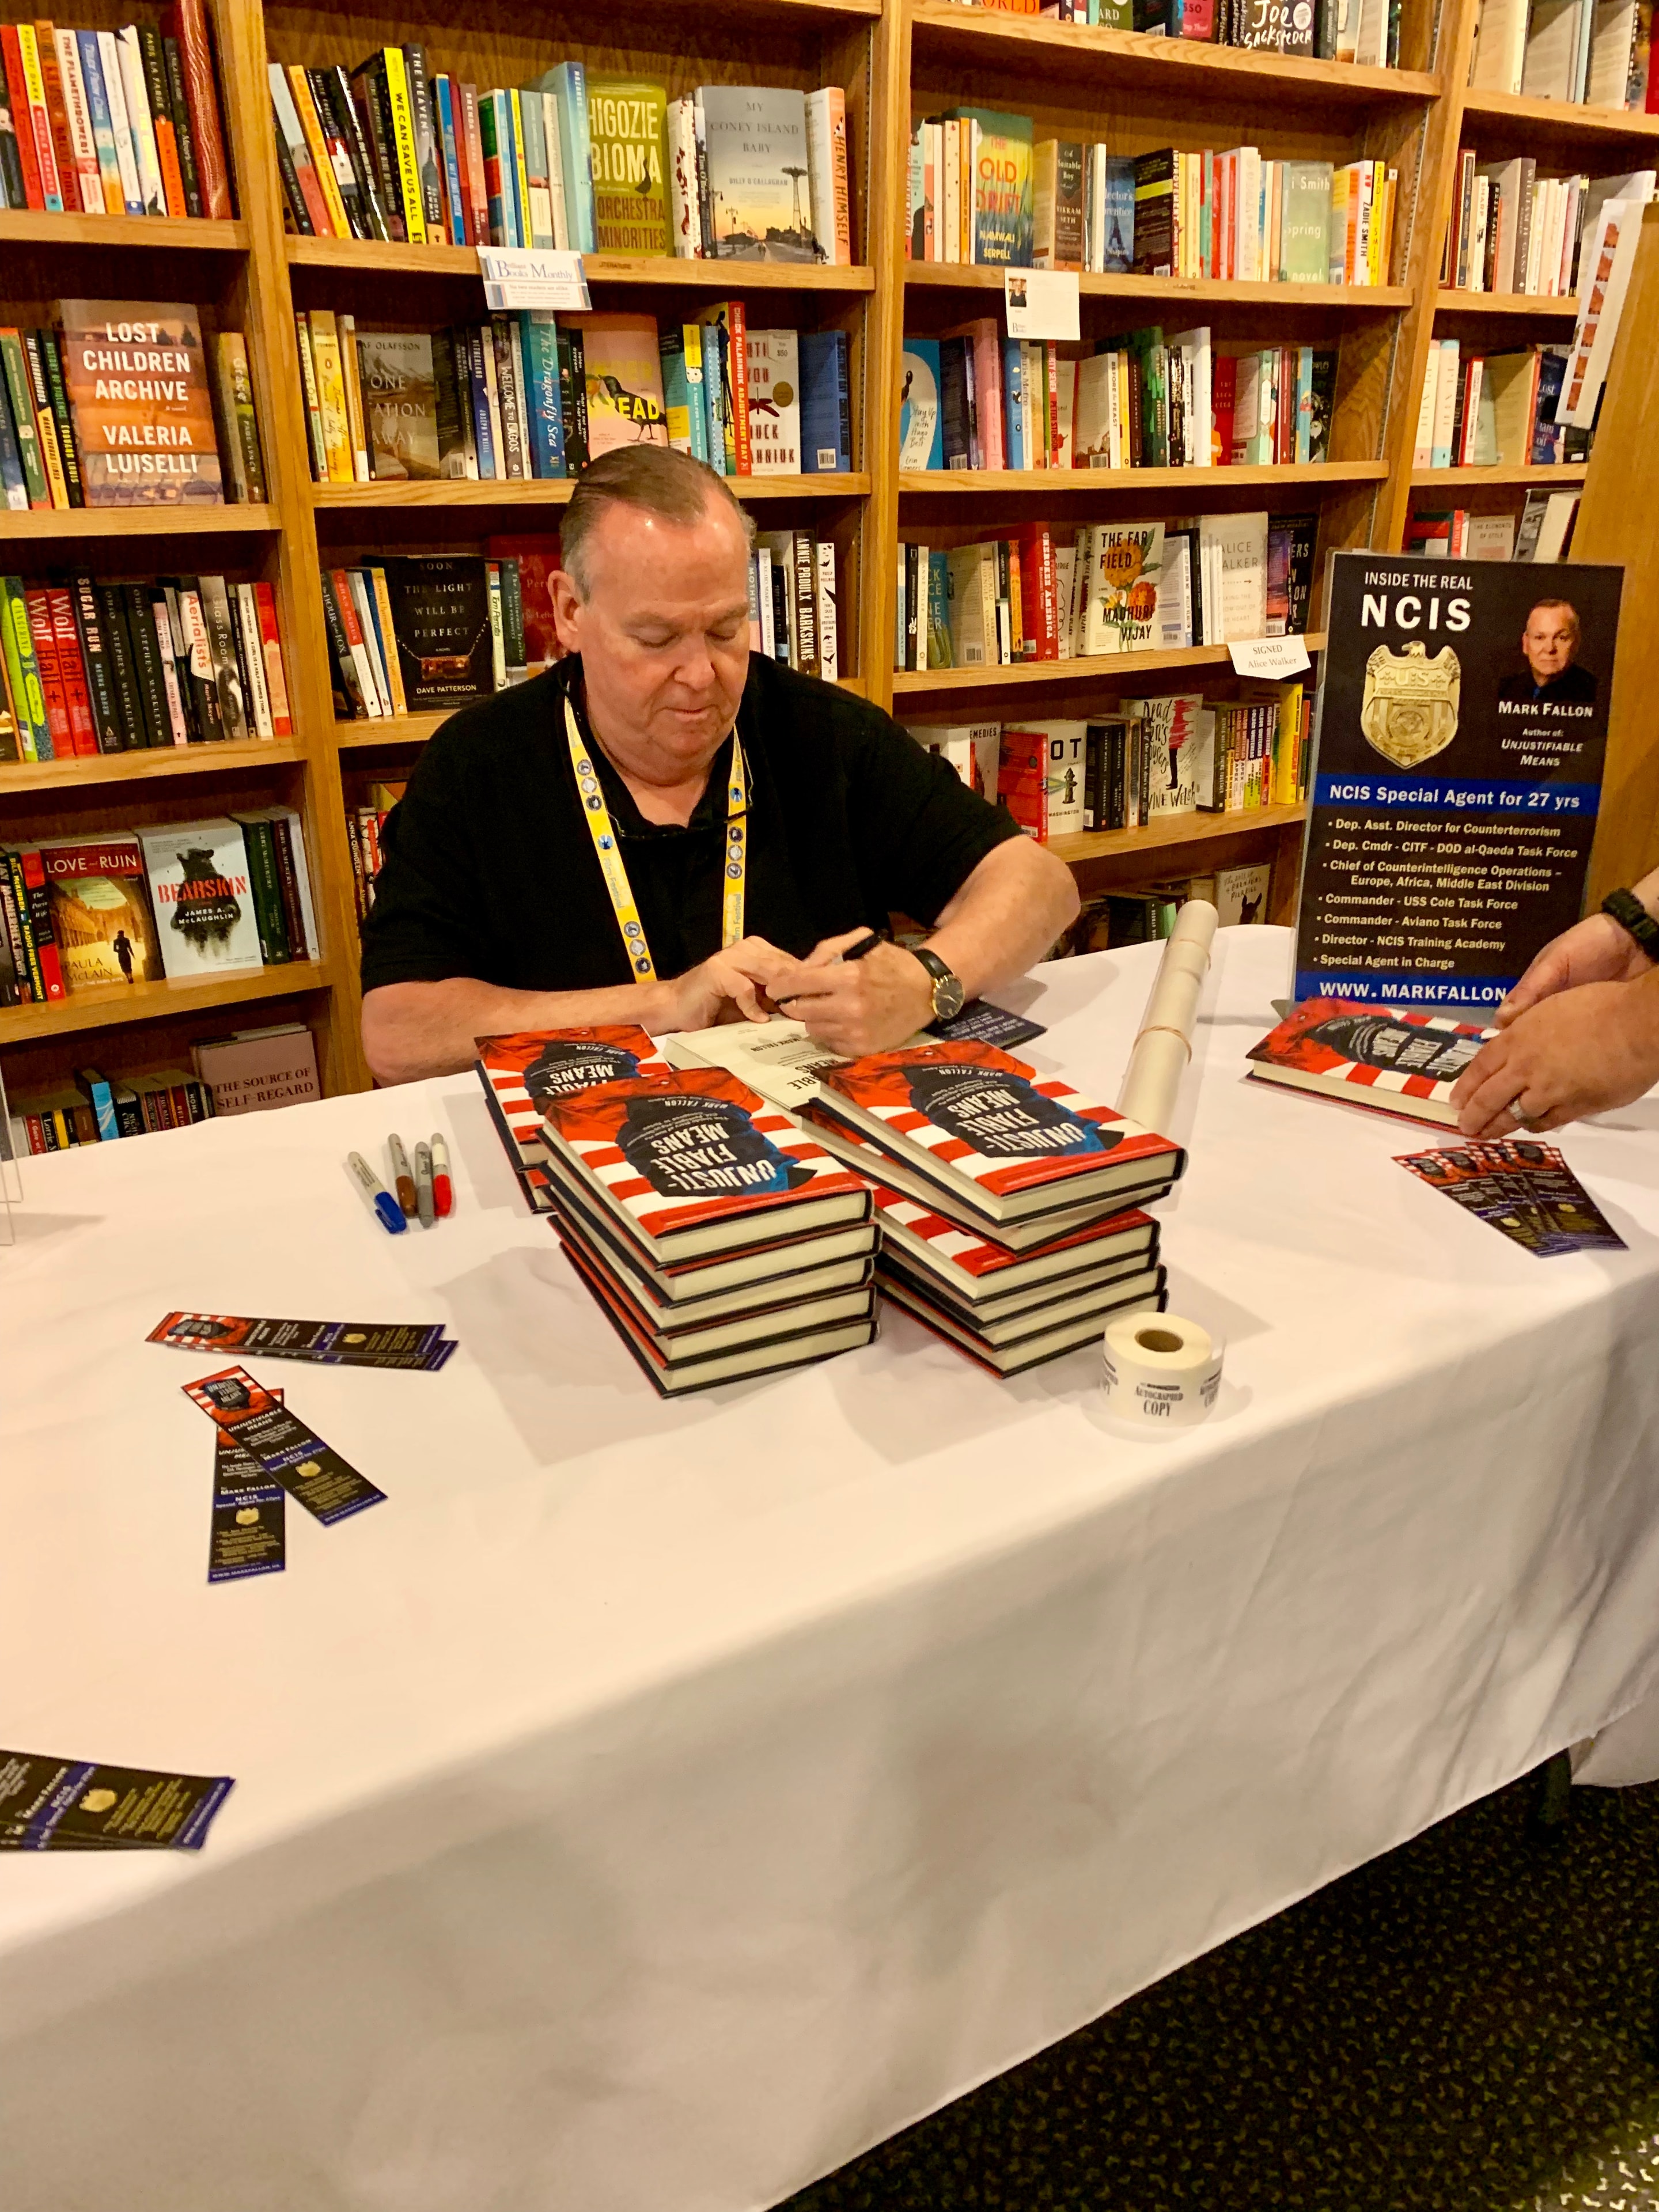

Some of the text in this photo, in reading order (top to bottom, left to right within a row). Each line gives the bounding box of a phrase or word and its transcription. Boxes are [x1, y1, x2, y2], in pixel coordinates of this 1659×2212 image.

[1244, 28, 1313, 50] SACKSTEDER
[63, 36, 89, 154] THE FLAMETHROWERS
[412, 52, 429, 137] THE HEAVENS
[747, 102, 763, 112] MY
[710, 122, 799, 135] CONEY ISLAND
[396, 93, 418, 221] WE CAN SAVE US ALL
[743, 142, 771, 154] BABY
[979, 157, 1017, 184] OLD
[834, 135, 850, 247] HENRY HIMSELF
[597, 196, 665, 221] ORCHESTRA
[976, 189, 1021, 215] DRIFT
[598, 225, 665, 250] MINORITIES
[980, 230, 1015, 244] NAMWALI
[1361, 229, 1369, 257] SMITH
[983, 248, 1011, 260] SERPELL
[105, 322, 159, 343] LOST
[83, 350, 190, 373] CHILDREN
[96, 380, 188, 401] ARCHIVE
[501, 366, 516, 410] WELCOME
[542, 358, 559, 421] Dragonfly
[734, 307, 748, 460] CHUCK PALAHNIUK ADJUSTMENT DAY
[103, 426, 192, 446] VALERIA
[507, 423, 520, 452] LAGOS
[547, 425, 558, 447] Sea
[105, 454, 198, 474] LUISELLI
[1101, 531, 1148, 547] THE FAR
[1100, 552, 1132, 569] FIELD
[435, 583, 472, 593] LIGHT
[1043, 532, 1054, 638] CHEROKEE AMERICA
[1365, 572, 1473, 590] INSIDE THE REAL
[797, 538, 814, 660] ANNIE PROULX BARKSKINS
[77, 578, 102, 653] SUGAR RUN
[415, 605, 465, 615] WILL BE
[1103, 604, 1152, 624] MADHURI
[1361, 594, 1471, 631] NCIS
[51, 596, 81, 682] Wolf Hall
[187, 594, 209, 668] Aerialists
[415, 627, 469, 638] PERFECT
[1121, 625, 1152, 641] VIJAY
[1253, 645, 1282, 656] SIGNED
[1248, 657, 1297, 668] Alice Walker
[416, 684, 476, 694] DAVE PATTERSON
[1498, 700, 1593, 718] MARK FALLON
[1522, 728, 1550, 737] Author
[1501, 738, 1584, 752] UNJUSTIFIABLE
[1520, 755, 1560, 767] MEANS
[1330, 785, 1580, 810] NCIS Special Agent for 27 yrs
[1336, 819, 1560, 837] Dep. Asst. Director for Counterterrorism
[351, 840, 361, 874] QUINDLEN
[1333, 840, 1577, 858] Dep. Cmdr CITF DOD al-Qaeda Task Force
[47, 854, 137, 873] LOVE RUIN
[1330, 861, 1552, 878] Chief of Counterintelligence Operations
[157, 875, 248, 903] BEARSKIN
[1351, 876, 1550, 892] Europe, Africa, Middle East Division
[184, 908, 213, 917] JAMES
[733, 893, 741, 926] Festival
[1325, 894, 1518, 910] Commander USS Cole Task Force
[179, 914, 233, 924] McLAUGHLIN
[1324, 914, 1502, 930] Commander Aviano Task Force
[1322, 934, 1506, 951] Director NCIS Training Academy
[23, 925, 43, 999] RADIO FREE VERMONT
[1320, 955, 1455, 969] Special Agent in Charge
[1320, 982, 1506, 1001] WWW.MARKFALLON
[214, 1068, 310, 1093] THE SOURCE OF
[549, 1064, 614, 1084] MEANS
[218, 1082, 313, 1109] SELF-REGARD
[947, 1089, 1020, 1118] MEANS
[956, 1108, 1039, 1136] FIABLE
[651, 1123, 729, 1154] MEANS
[984, 1122, 1086, 1152] UNJUSTI-
[650, 1143, 737, 1174] FIABLE
[668, 1160, 776, 1190] UNJUSTI-
[1144, 1400, 1170, 1416] COPY
